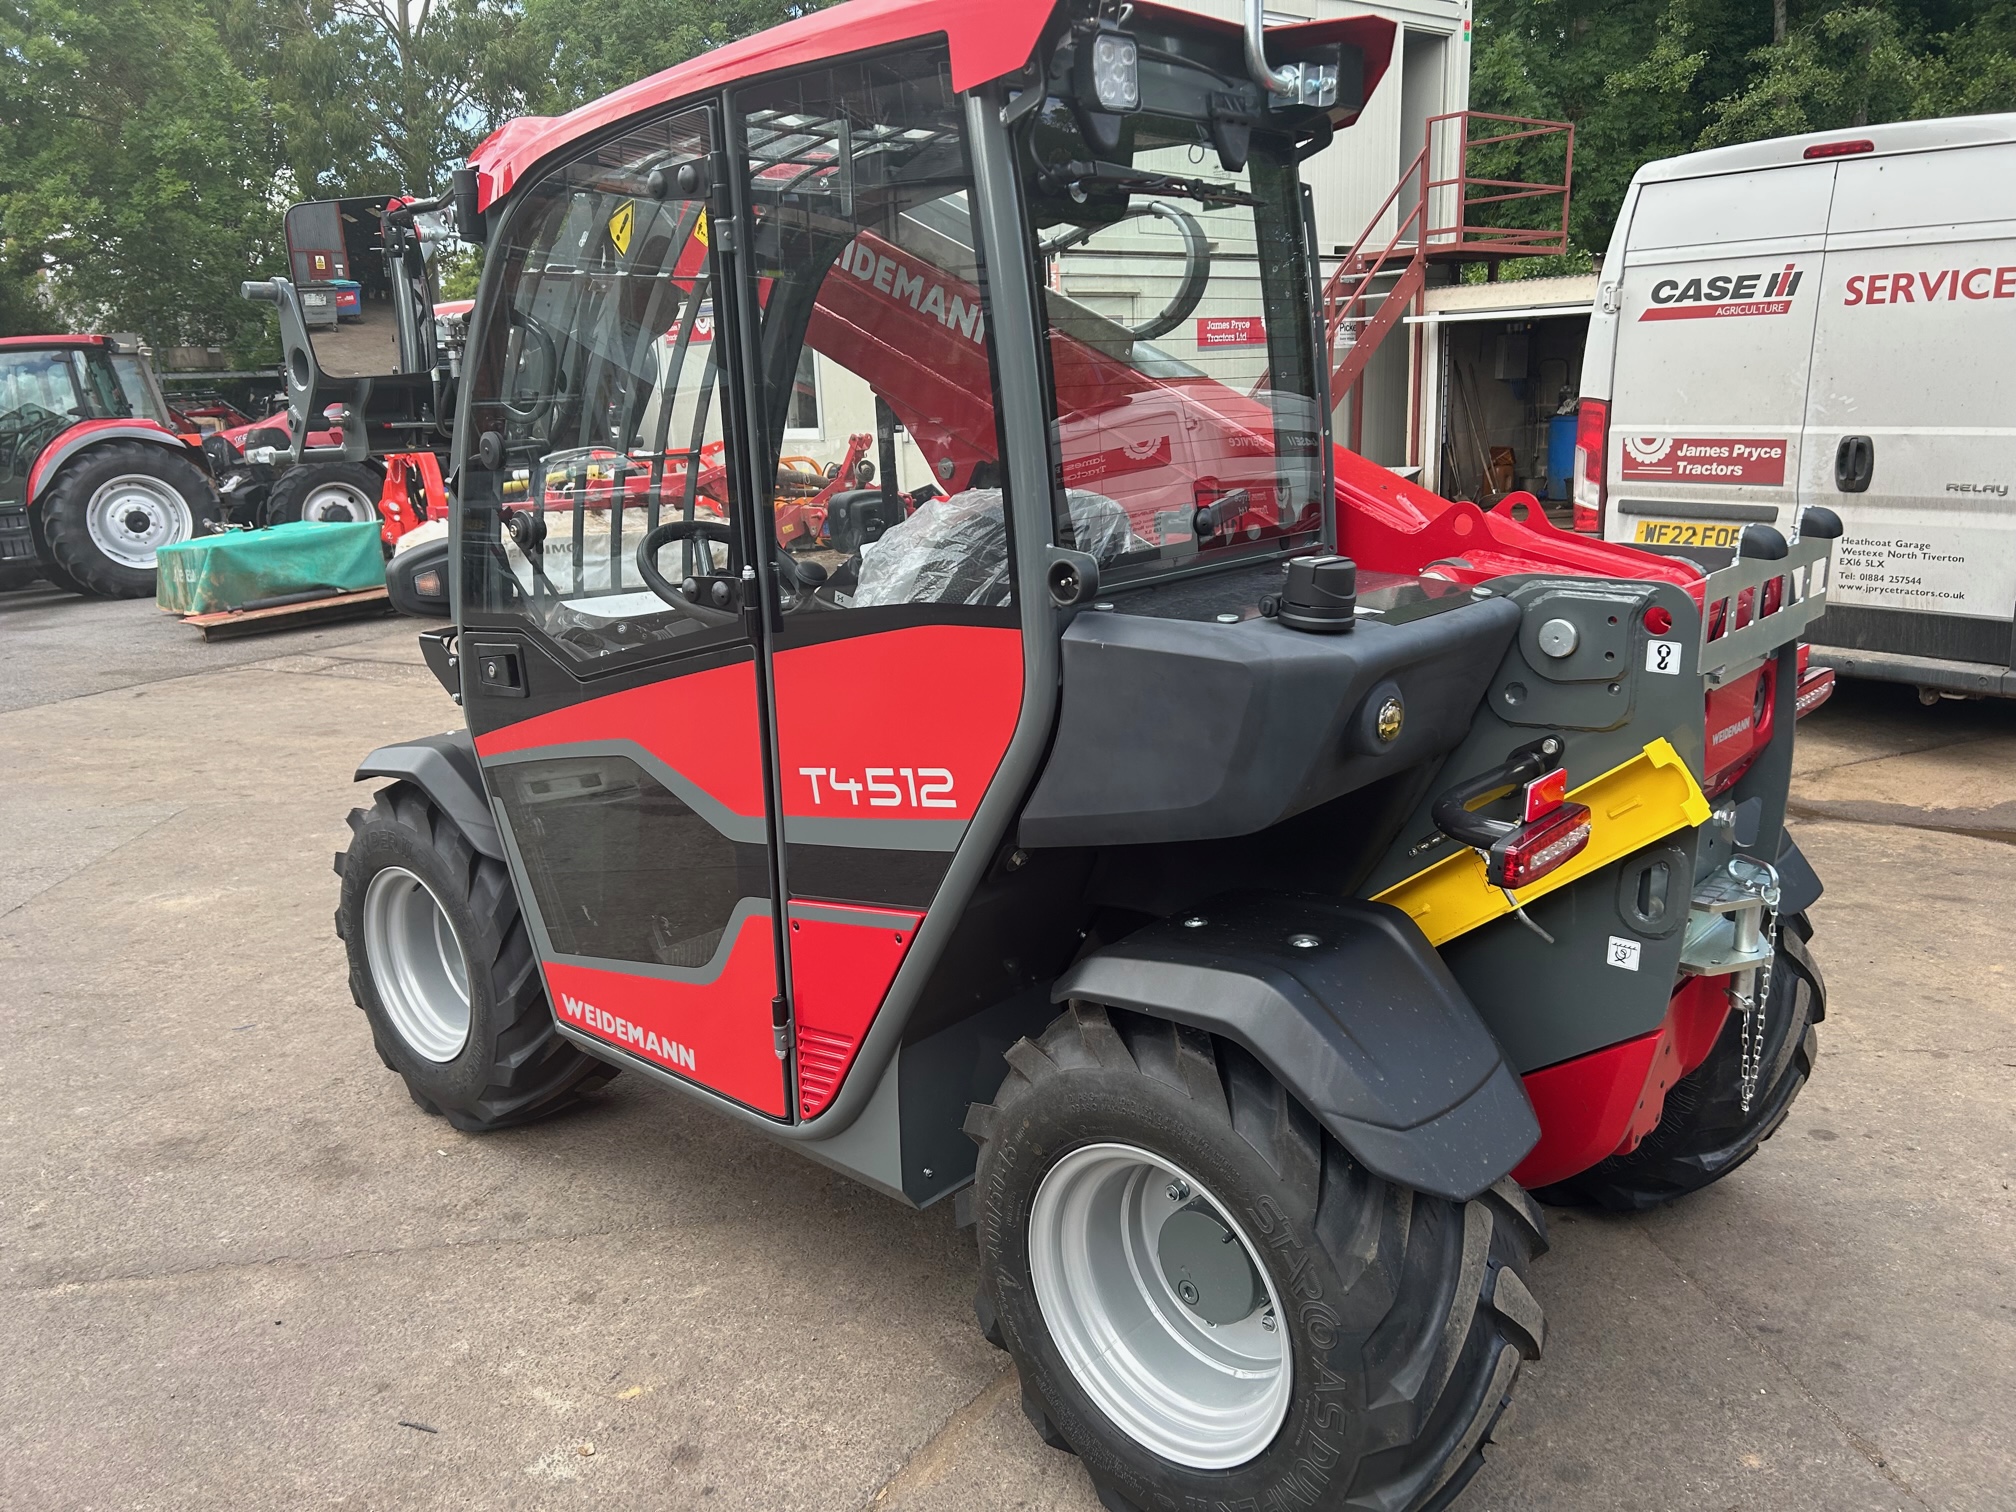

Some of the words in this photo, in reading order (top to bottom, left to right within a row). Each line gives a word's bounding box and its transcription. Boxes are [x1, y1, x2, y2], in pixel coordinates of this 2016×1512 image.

[833, 239, 985, 345] IDEMAN
[1651, 273, 1762, 304] CASE
[1844, 266, 2016, 306] SERVICE
[1715, 303, 1784, 316] AGRICULTURE
[1207, 320, 1230, 330] James
[1231, 320, 1250, 331] Pryce
[1207, 333, 1235, 343] Tractors
[1236, 332, 1247, 342] Ltd
[1677, 443, 1729, 457] James
[1732, 444, 1782, 461] Pryce
[1677, 461, 1743, 476] Tractors
[1644, 524, 1696, 546] WF22
[1841, 537, 1892, 547] Heathcoat
[1895, 540, 1931, 551] Garage
[1839, 558, 1861, 567] EX16
[1865, 559, 1885, 568] 5LX
[1841, 547, 1883, 557] Westexe
[1888, 550, 1917, 560] North
[1921, 552, 1965, 563] Tiverton
[1839, 572, 1856, 581] Tel:
[1859, 573, 1885, 583] 01884
[1888, 575, 1922, 585] 257544
[1838, 583, 1965, 600] www.jprycetractors.co.uk
[1712, 716, 1750, 746] WEIDEMANN
[799, 767, 957, 808] T4512
[561, 992, 696, 1071] WEIDEMANN
